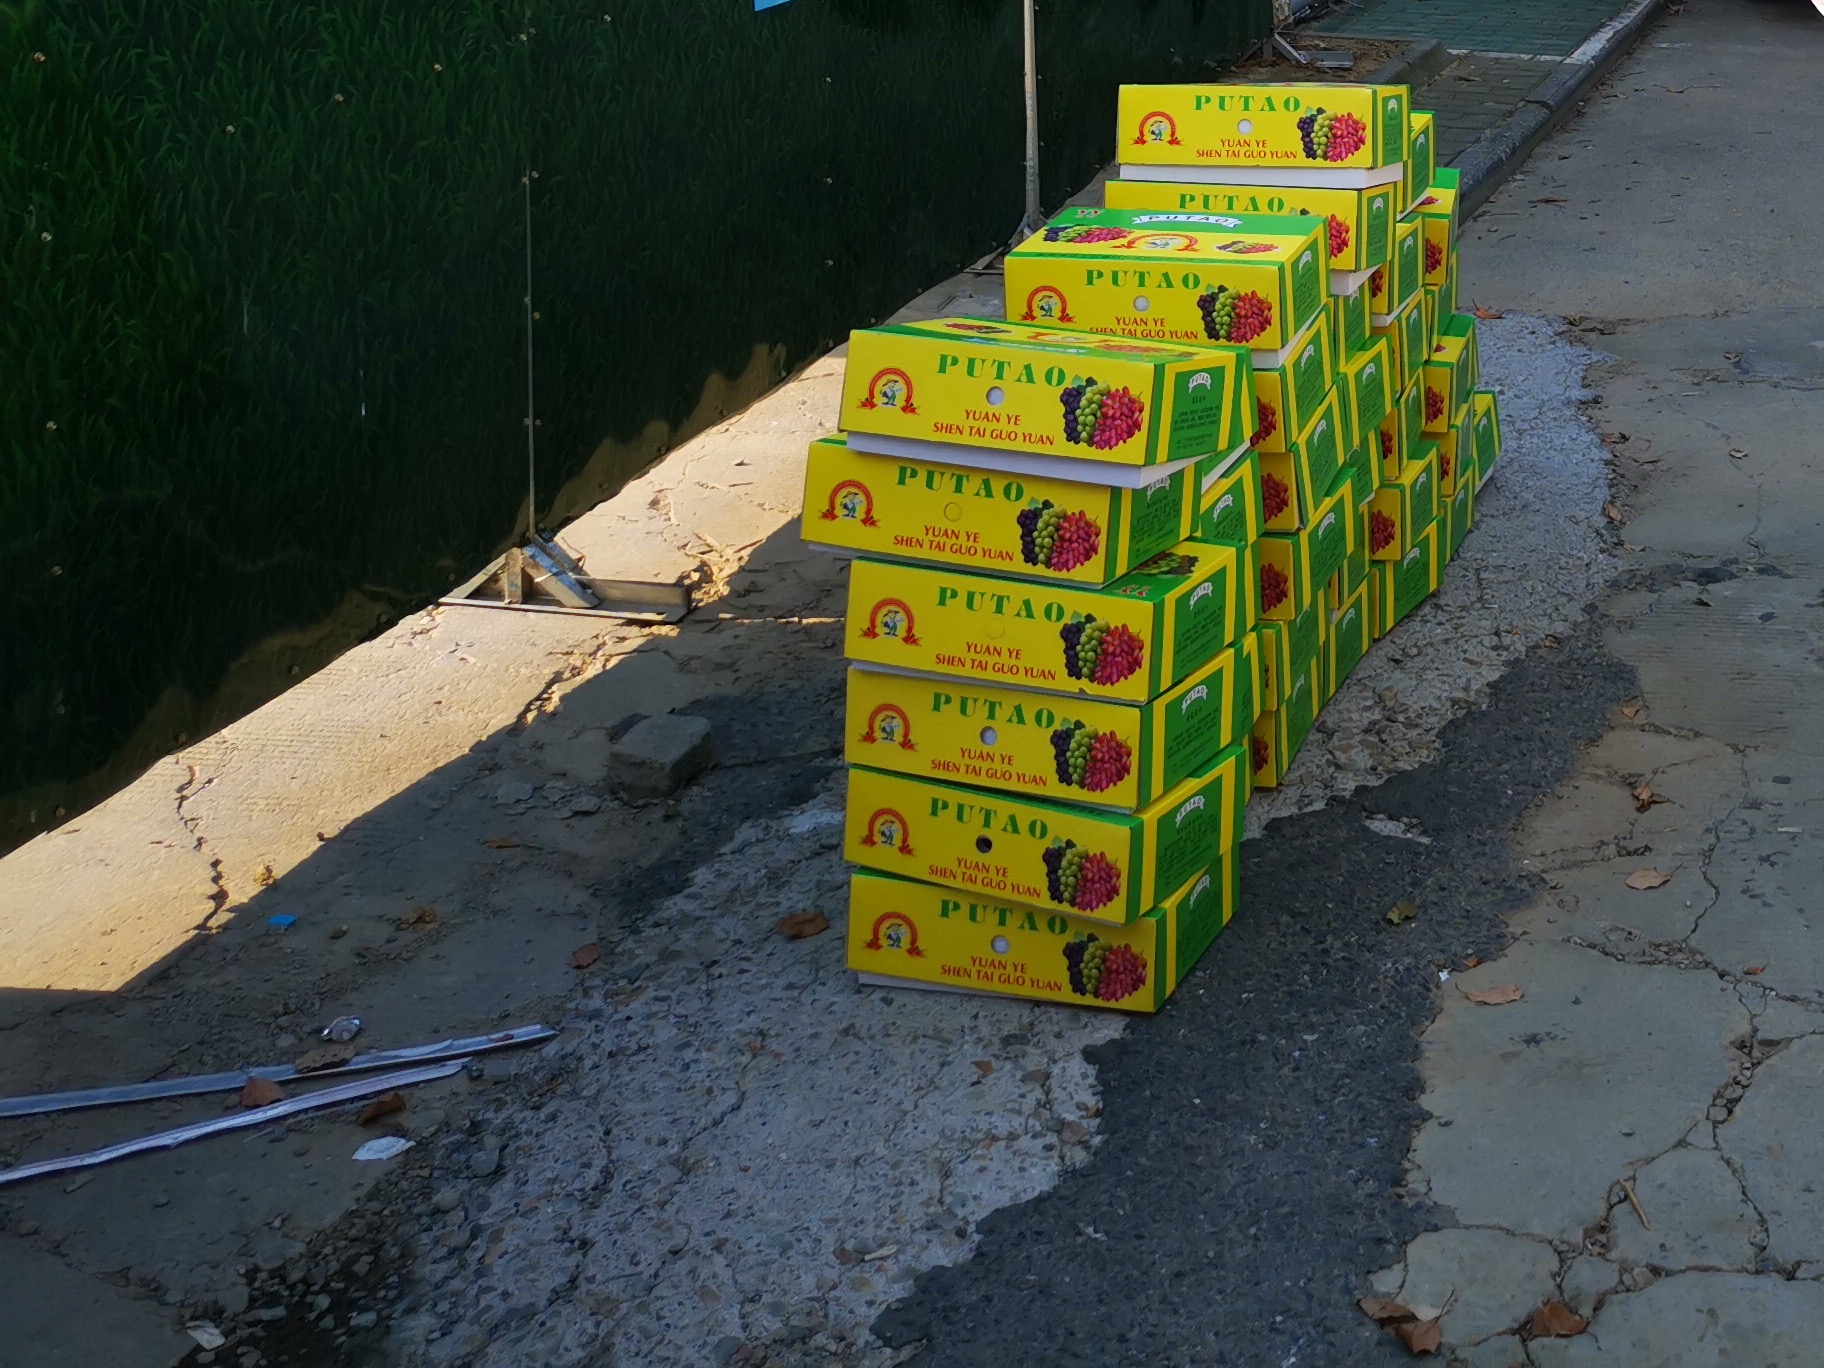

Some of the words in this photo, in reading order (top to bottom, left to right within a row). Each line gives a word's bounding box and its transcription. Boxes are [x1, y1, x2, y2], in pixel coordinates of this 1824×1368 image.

[1194, 95, 1302, 112] PUTAO
[1220, 139, 1251, 148] YUAN
[1256, 140, 1268, 148] YE
[1196, 149, 1222, 158] SHEN
[1226, 149, 1241, 158] TAI
[1244, 150, 1265, 159] GUO
[1270, 150, 1297, 159] YUAN
[1179, 193, 1285, 212] PUTAO
[1148, 215, 1229, 223] PUTAO
[1085, 269, 1201, 290] PUTAO
[1115, 316, 1147, 326] YUAN
[1152, 317, 1166, 326] YE
[1140, 329, 1166, 338] GUO
[1170, 329, 1198, 340] YUAN
[937, 353, 1065, 387] PUTAO
[964, 409, 1000, 424] YUAN
[1005, 414, 1021, 425] YE
[933, 422, 964, 435] SHEN
[967, 425, 986, 437] TAI
[991, 427, 1017, 441] GUO
[1022, 432, 1054, 446] YUAN
[896, 466, 1024, 503] PUTAO
[923, 525, 961, 541] YUAN
[964, 531, 980, 543] YE
[893, 535, 923, 548] SHEN
[927, 539, 947, 552] TAI
[950, 542, 978, 557] GUO
[982, 547, 1014, 562] YUAN
[936, 586, 1066, 623] PUTAO
[965, 642, 1001, 658] YUAN
[1006, 648, 1022, 660] YE
[935, 654, 965, 666] SHEN
[969, 657, 988, 671] TAI
[992, 661, 1020, 675] GUO
[1024, 665, 1056, 681] YUAN
[932, 692, 1055, 729] PUTAO
[960, 747, 995, 762] YUAN
[1000, 753, 1014, 765] YE
[931, 759, 960, 772] SHEN
[964, 763, 982, 776] TAI
[986, 766, 1012, 780] GUO
[1016, 772, 1047, 786] YUAN
[929, 798, 1048, 839] PUTAO
[956, 857, 991, 873] YUAN
[995, 864, 1009, 877] YE
[929, 864, 957, 880] SHEN
[961, 870, 979, 884] TAI
[982, 875, 1007, 890] GUO
[1011, 881, 1041, 898] YUAN
[939, 900, 1069, 935] PUTAO
[971, 956, 1007, 971] YUAN
[1012, 962, 1027, 973] YE
[941, 965, 971, 979] SHEN
[975, 970, 994, 982] TAI
[998, 972, 1025, 987] GUO
[1030, 978, 1062, 993] YUAN
